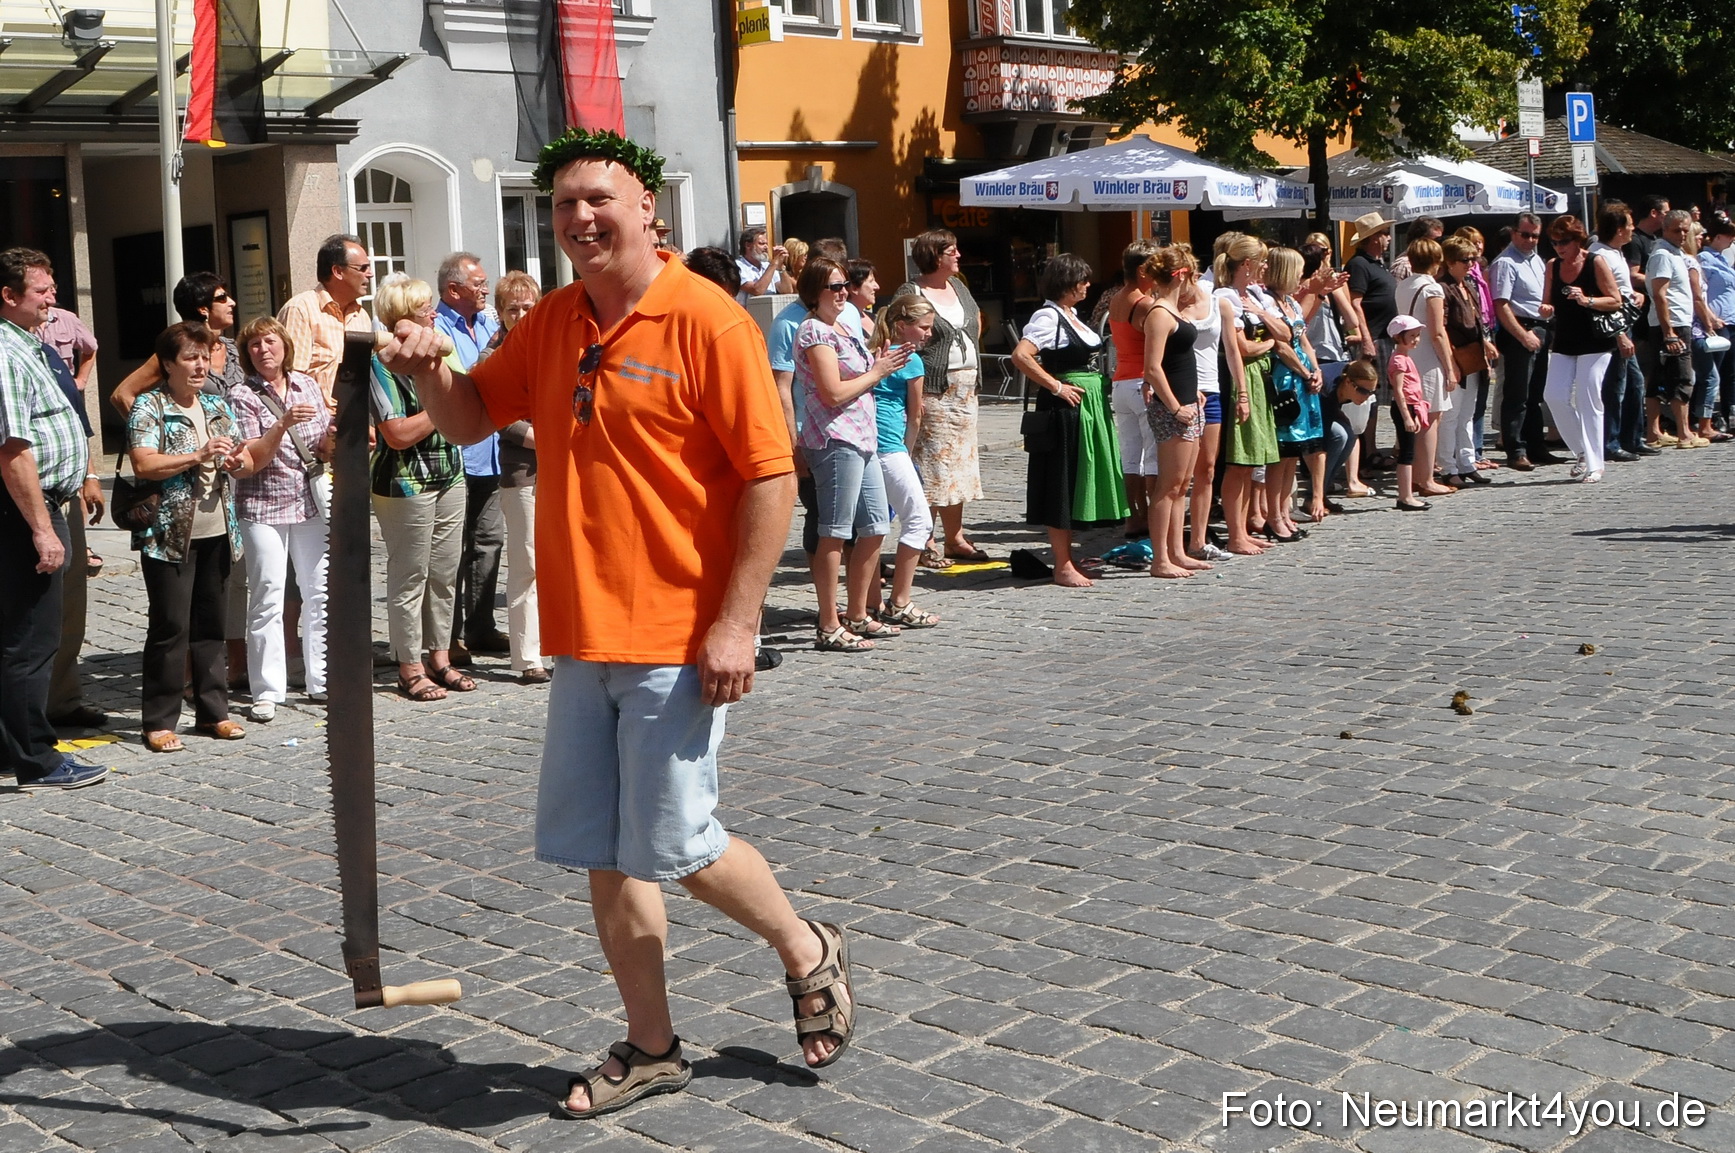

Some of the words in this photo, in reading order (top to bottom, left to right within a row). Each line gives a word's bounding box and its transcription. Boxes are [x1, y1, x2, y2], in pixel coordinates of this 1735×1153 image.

[739, 12, 770, 40] plank
[1572, 99, 1589, 136] P
[975, 181, 1016, 196] Winkler
[1019, 181, 1044, 196] Bräu
[1093, 180, 1140, 194] Winkler
[1143, 179, 1171, 194] Bräu
[1361, 185, 1382, 199] Bräu
[1444, 184, 1464, 197] Bräu
[1496, 186, 1524, 200] Winkler
